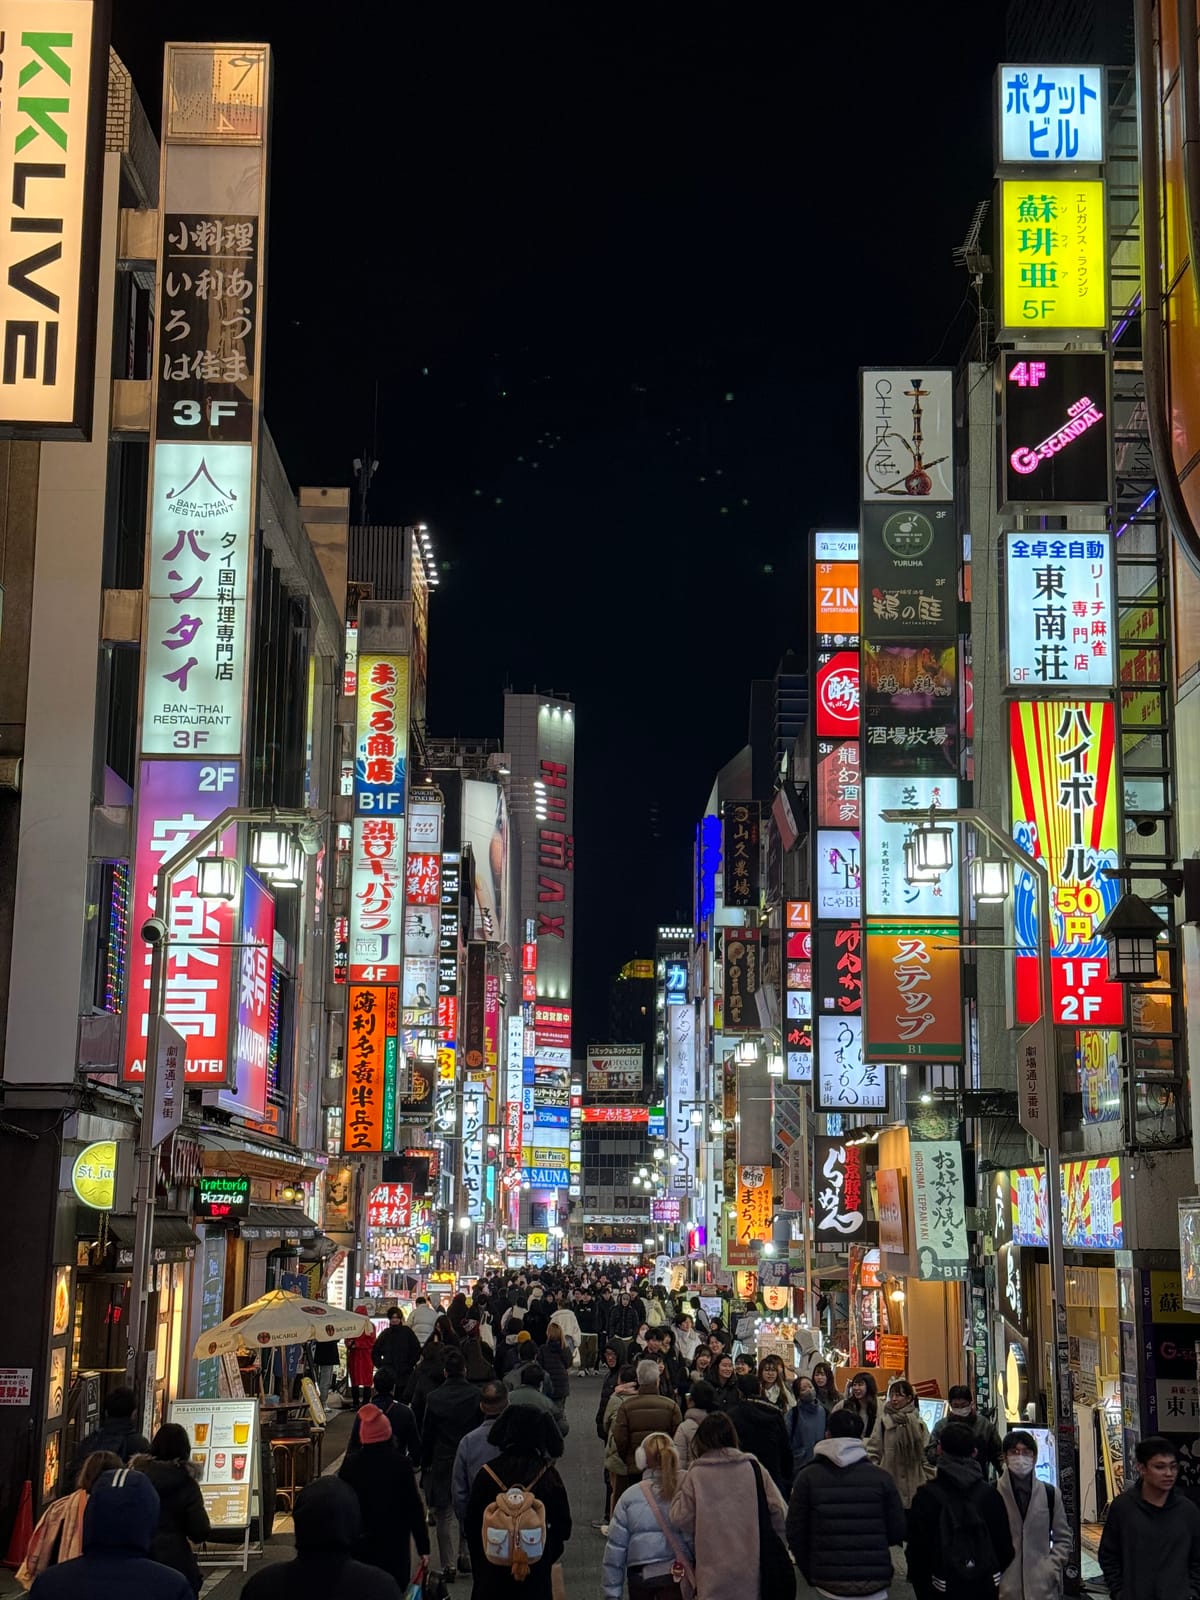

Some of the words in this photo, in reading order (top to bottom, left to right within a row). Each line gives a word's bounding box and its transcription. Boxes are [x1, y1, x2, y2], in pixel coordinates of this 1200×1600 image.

[1006, 72, 1097, 115] ポケット
[1028, 118, 1079, 160] ビル
[2, 31, 73, 386] KKLIVE
[167, 219, 254, 253] 小料理
[1022, 299, 1057, 320] 5F
[163, 271, 192, 382] いろは
[1008, 362, 1046, 387] 4F
[172, 399, 239, 428] 3F
[1067, 396, 1091, 418] CLUB
[1010, 406, 1104, 475] G-SCANDAL
[167, 503, 235, 520] RESTAURANT
[176, 498, 226, 512] BAN-THAI
[1011, 540, 1104, 560] 全卓全自動
[820, 564, 833, 574] 5F
[215, 531, 238, 681] タイ国料理専門店
[820, 587, 859, 607] ZIN
[161, 528, 212, 693] バンタイ
[1091, 563, 1108, 657] リーチ麻雀
[1031, 563, 1069, 682] 東南荘
[1071, 600, 1089, 671] 専門店
[818, 653, 831, 663] 4F
[1013, 667, 1031, 681] 3F
[153, 715, 232, 725] RESTAURANT
[163, 703, 225, 714] BAN-THAI
[365, 662, 397, 785] まぐろ商店
[172, 730, 210, 750] 3F
[867, 726, 949, 745] 酒場牧場
[818, 743, 834, 753] 3F
[199, 766, 236, 792] 2F
[359, 792, 400, 810] B1F
[1056, 707, 1097, 883] ハイボール
[406, 856, 440, 877] 湖南
[406, 877, 439, 895] 菜館
[1056, 886, 1100, 914] 50
[1064, 915, 1093, 944] 円
[361, 966, 388, 981] 4F
[1062, 962, 1101, 988] 1F
[892, 937, 936, 1041] ステップ
[1060, 996, 1102, 1021] 2F
[907, 1044, 923, 1054] B1
[834, 1020, 859, 1105] うまいもん
[162, 1045, 179, 1120] 劇場通り一番街
[1025, 1046, 1039, 1119] 劇場通り一番街
[862, 1095, 884, 1106] B1F
[531, 1169, 569, 1183] SAUNA
[914, 1150, 926, 1190] HIROSHIMA
[200, 1177, 248, 1192] Trattoria
[369, 1184, 409, 1206] 湖南
[200, 1192, 244, 1204] Pizzeria
[210, 1204, 233, 1215] Bar
[929, 1149, 964, 1249] お好み焼き
[378, 1207, 408, 1225] 菜館
[919, 1193, 929, 1241] TEPPANYAKI
[943, 1266, 968, 1278] B1F
